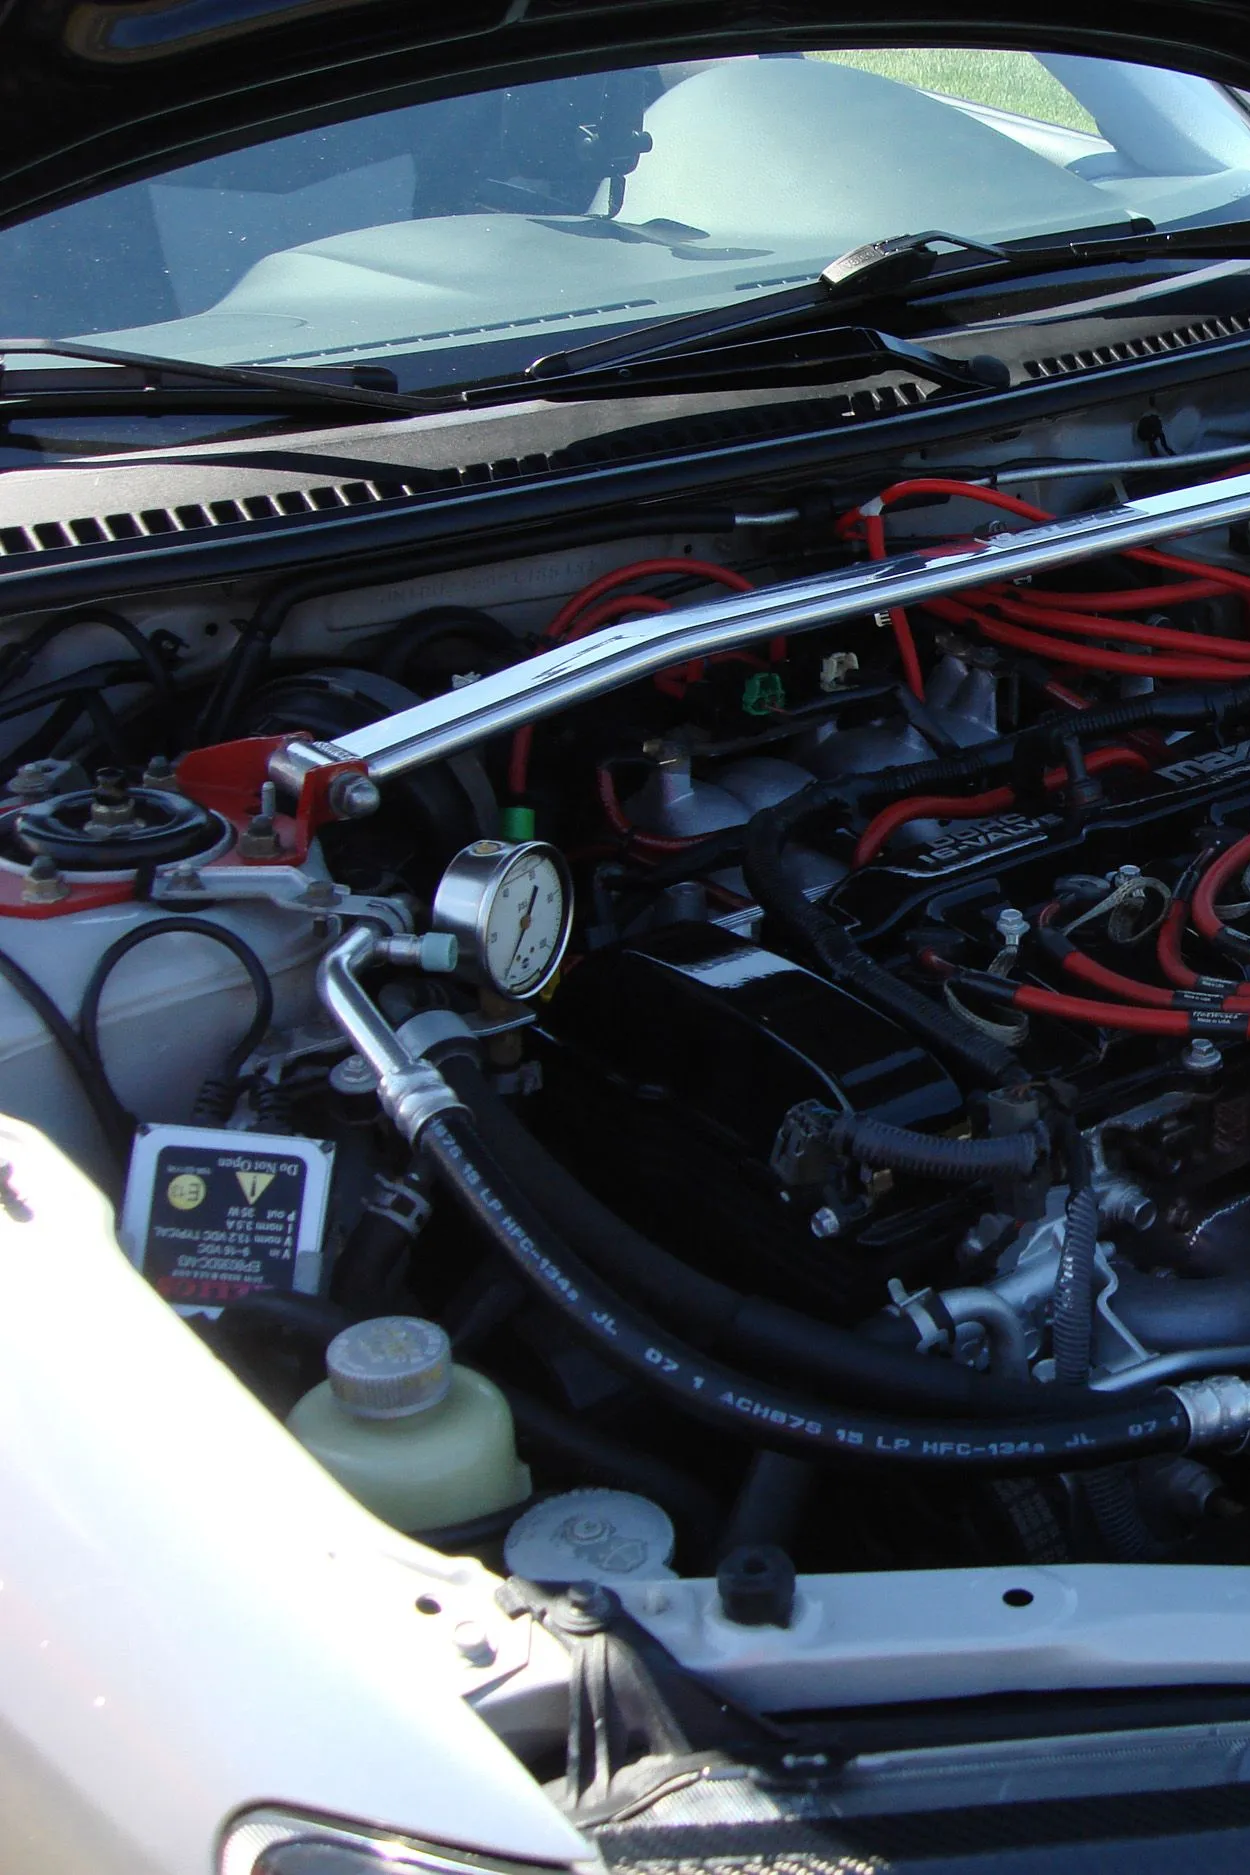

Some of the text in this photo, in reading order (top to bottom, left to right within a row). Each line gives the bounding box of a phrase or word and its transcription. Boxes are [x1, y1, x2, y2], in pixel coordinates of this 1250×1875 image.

[218, 1157, 251, 1171] Open
[255, 1161, 276, 1173] Not
[281, 1164, 298, 1175] Do
[645, 1348, 679, 1372] 07
[876, 1436, 911, 1450] LP
